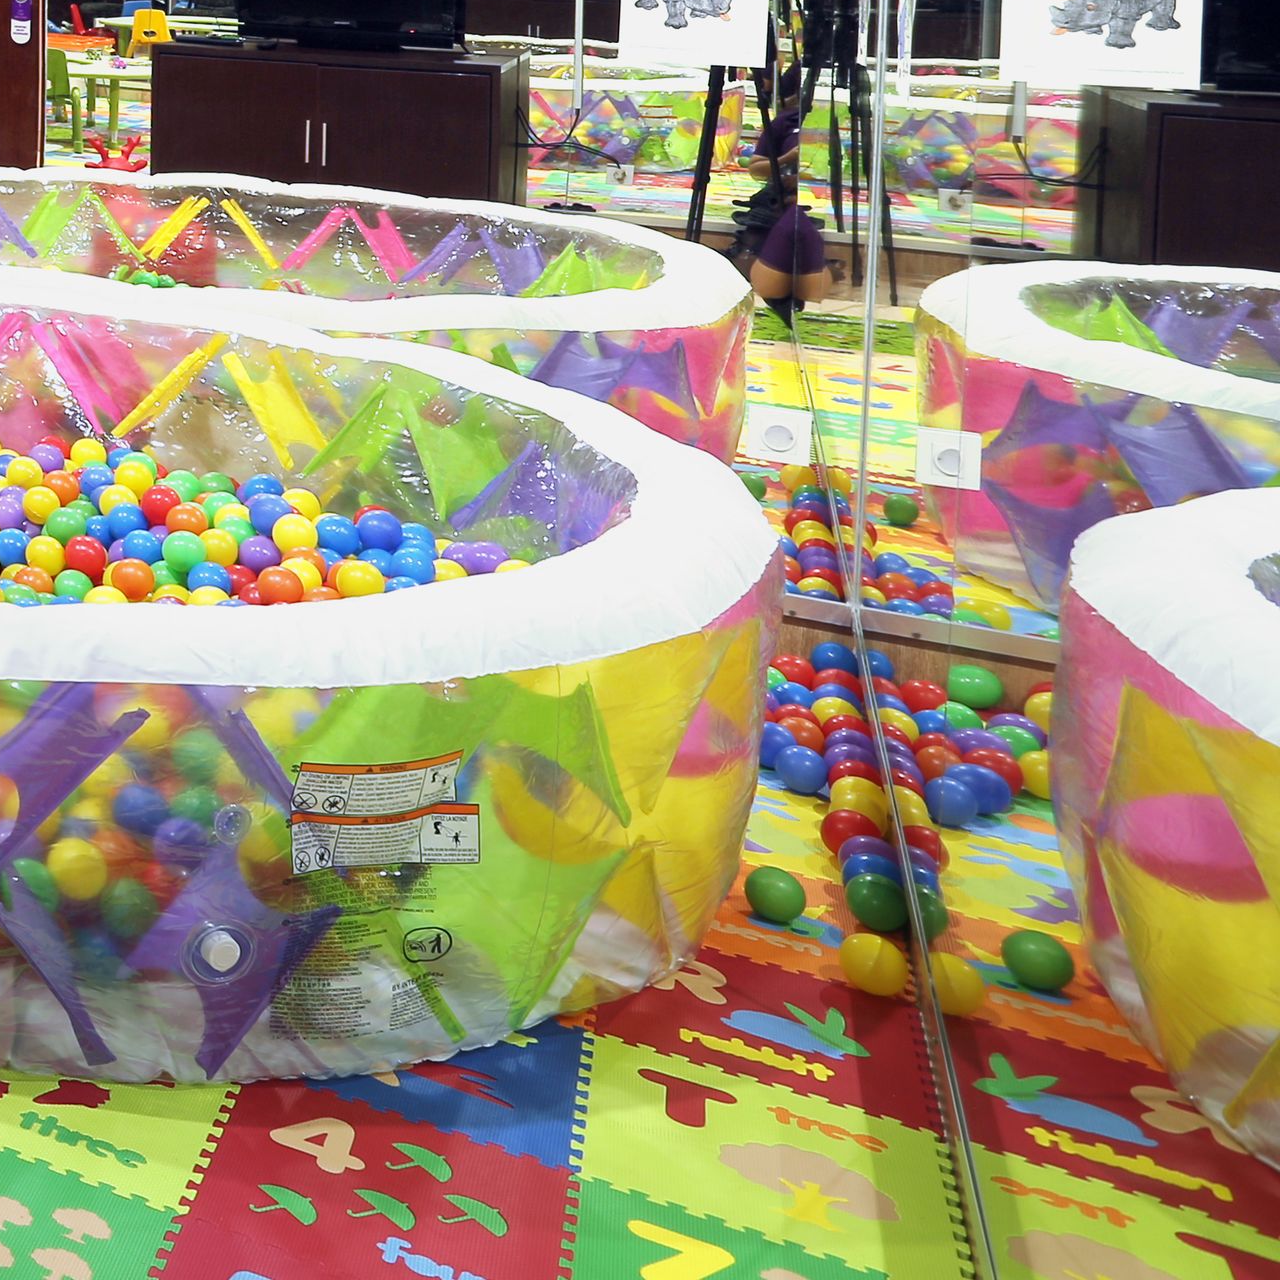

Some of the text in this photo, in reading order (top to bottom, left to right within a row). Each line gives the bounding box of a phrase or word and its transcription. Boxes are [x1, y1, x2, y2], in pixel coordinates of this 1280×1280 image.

[679, 1028, 836, 1082] rabbit
[637, 1068, 739, 1129] T
[17, 1110, 148, 1170] three
[269, 1116, 366, 1175] 4
[766, 1106, 889, 1153] tree
